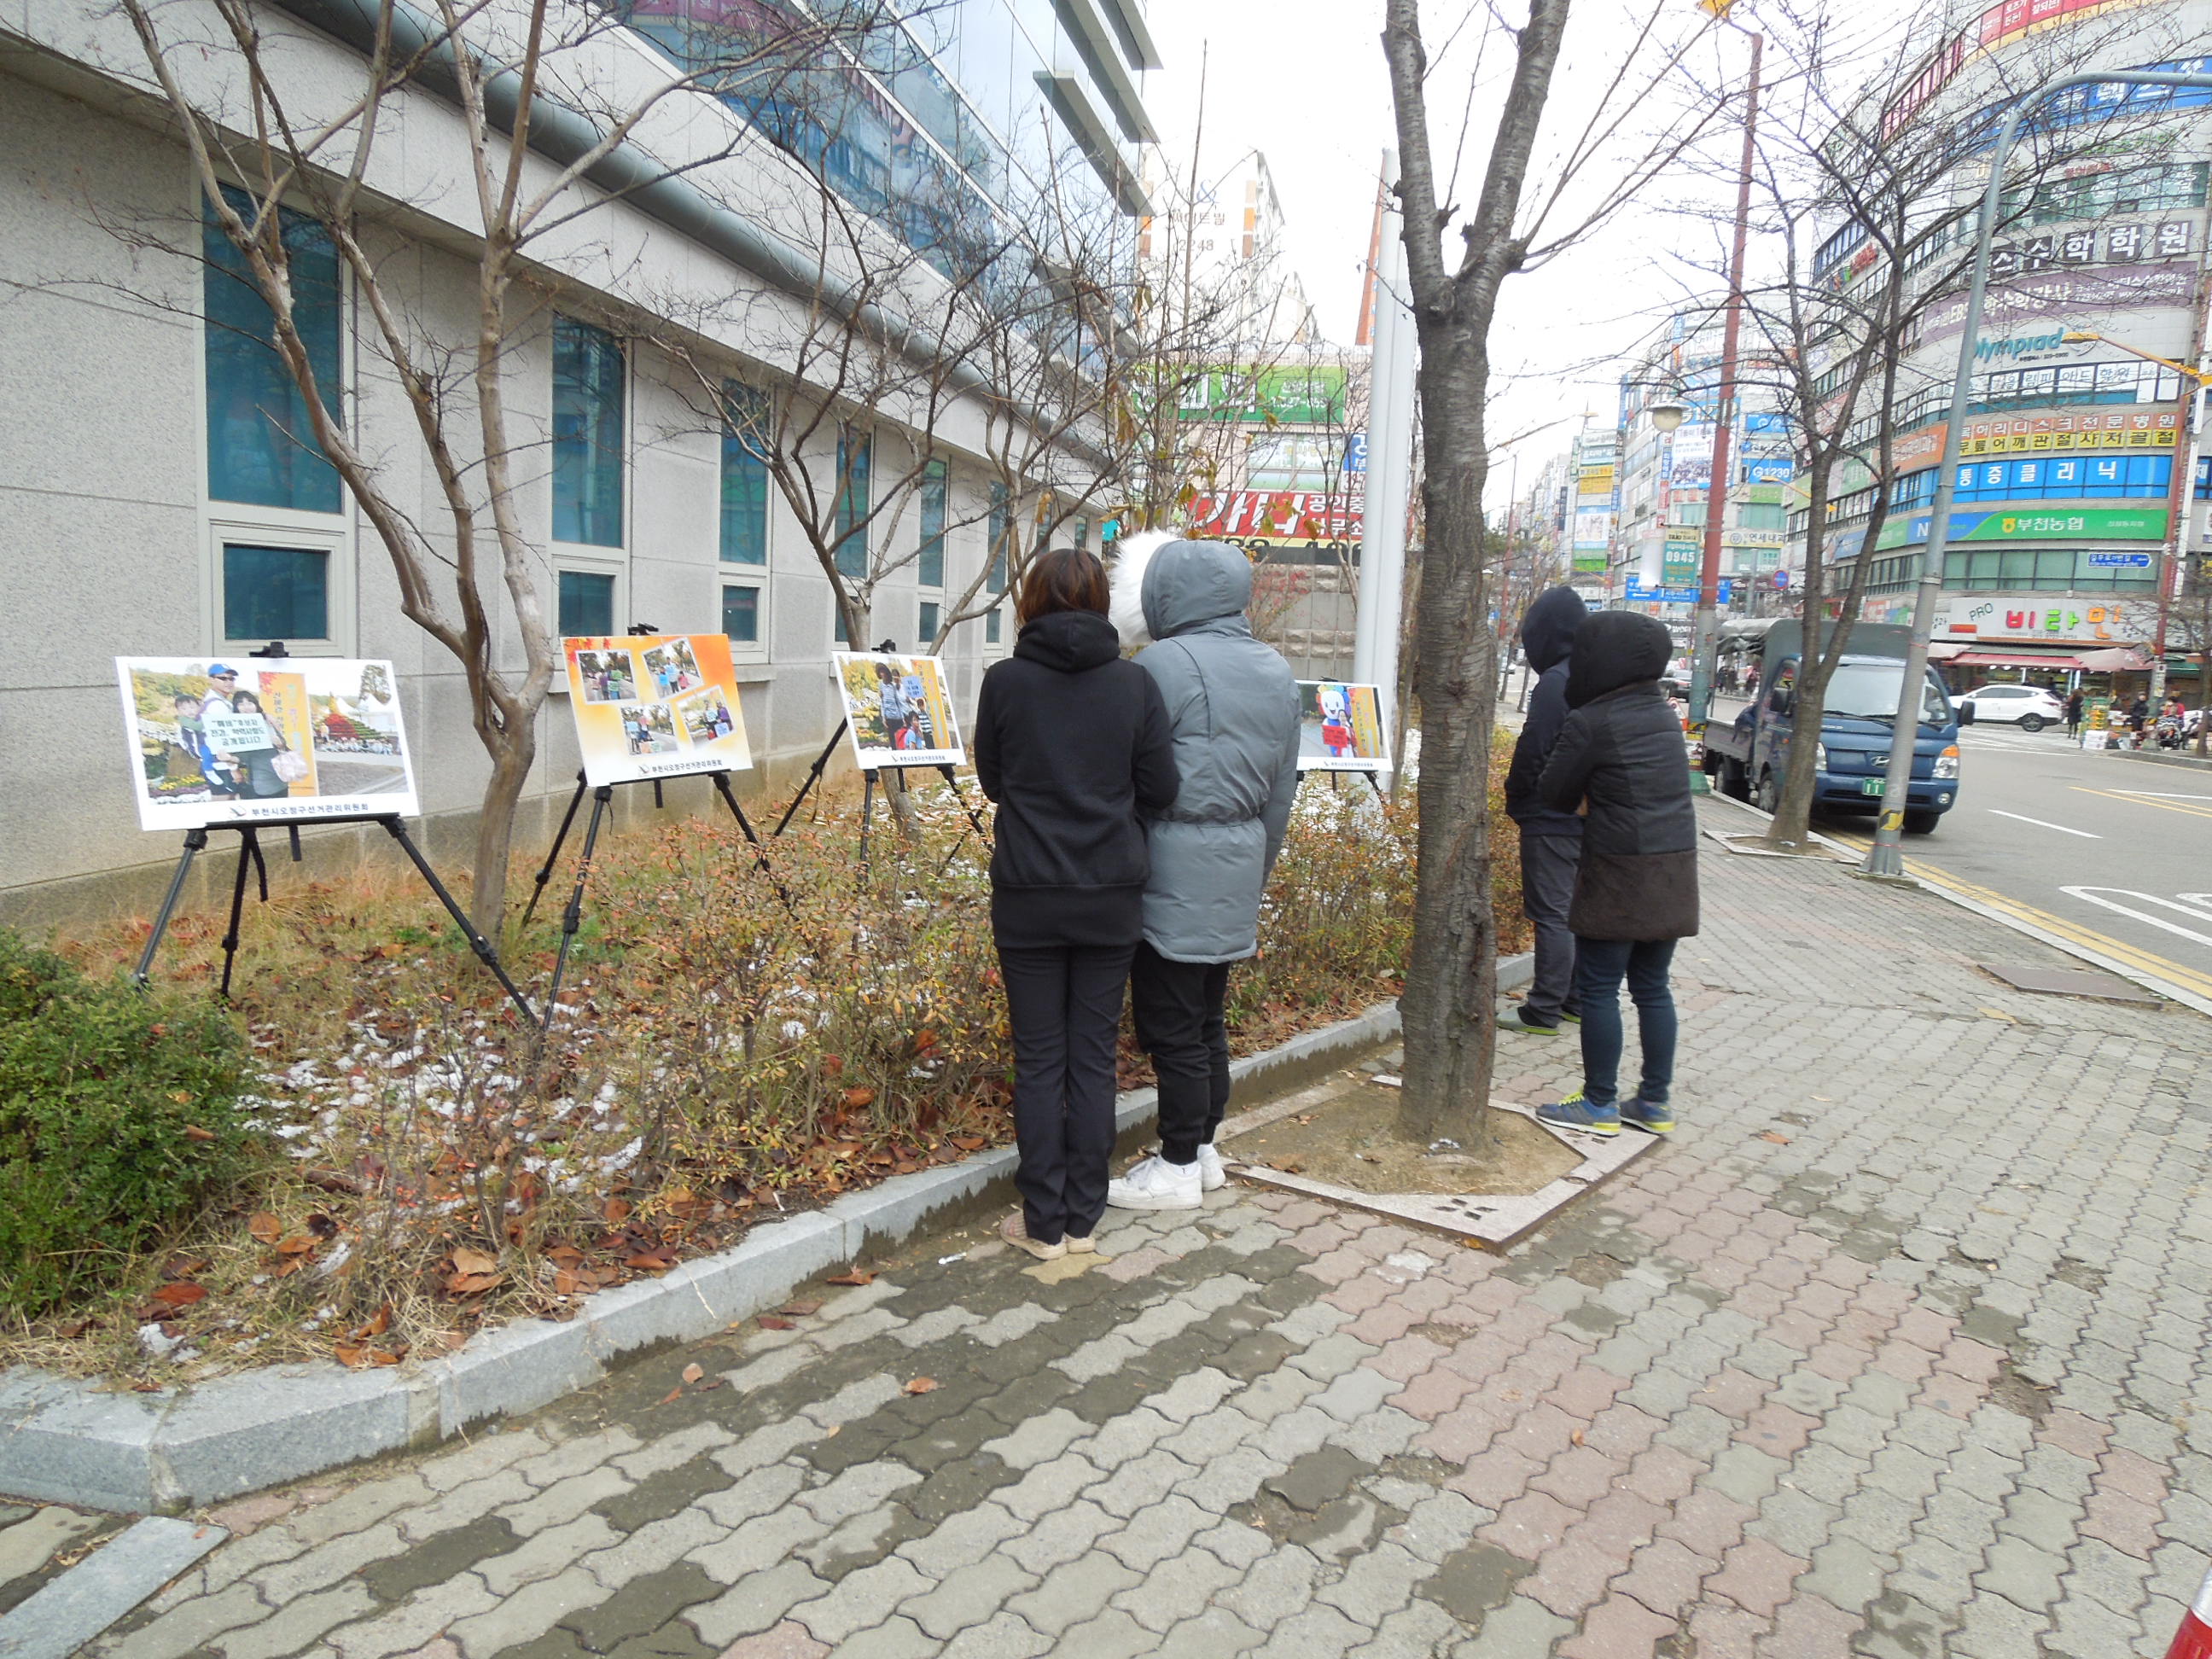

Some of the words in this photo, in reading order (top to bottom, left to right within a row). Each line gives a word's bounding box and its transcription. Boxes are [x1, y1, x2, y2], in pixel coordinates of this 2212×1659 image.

[1974, 328, 2064, 364] lympiad
[1959, 461, 2116, 486] 통증클리닉
[2017, 517, 2085, 531] 부천농협
[1666, 550, 1695, 563] 0945
[1969, 602, 1994, 620] PRO
[2006, 606, 2122, 640] 비타민
